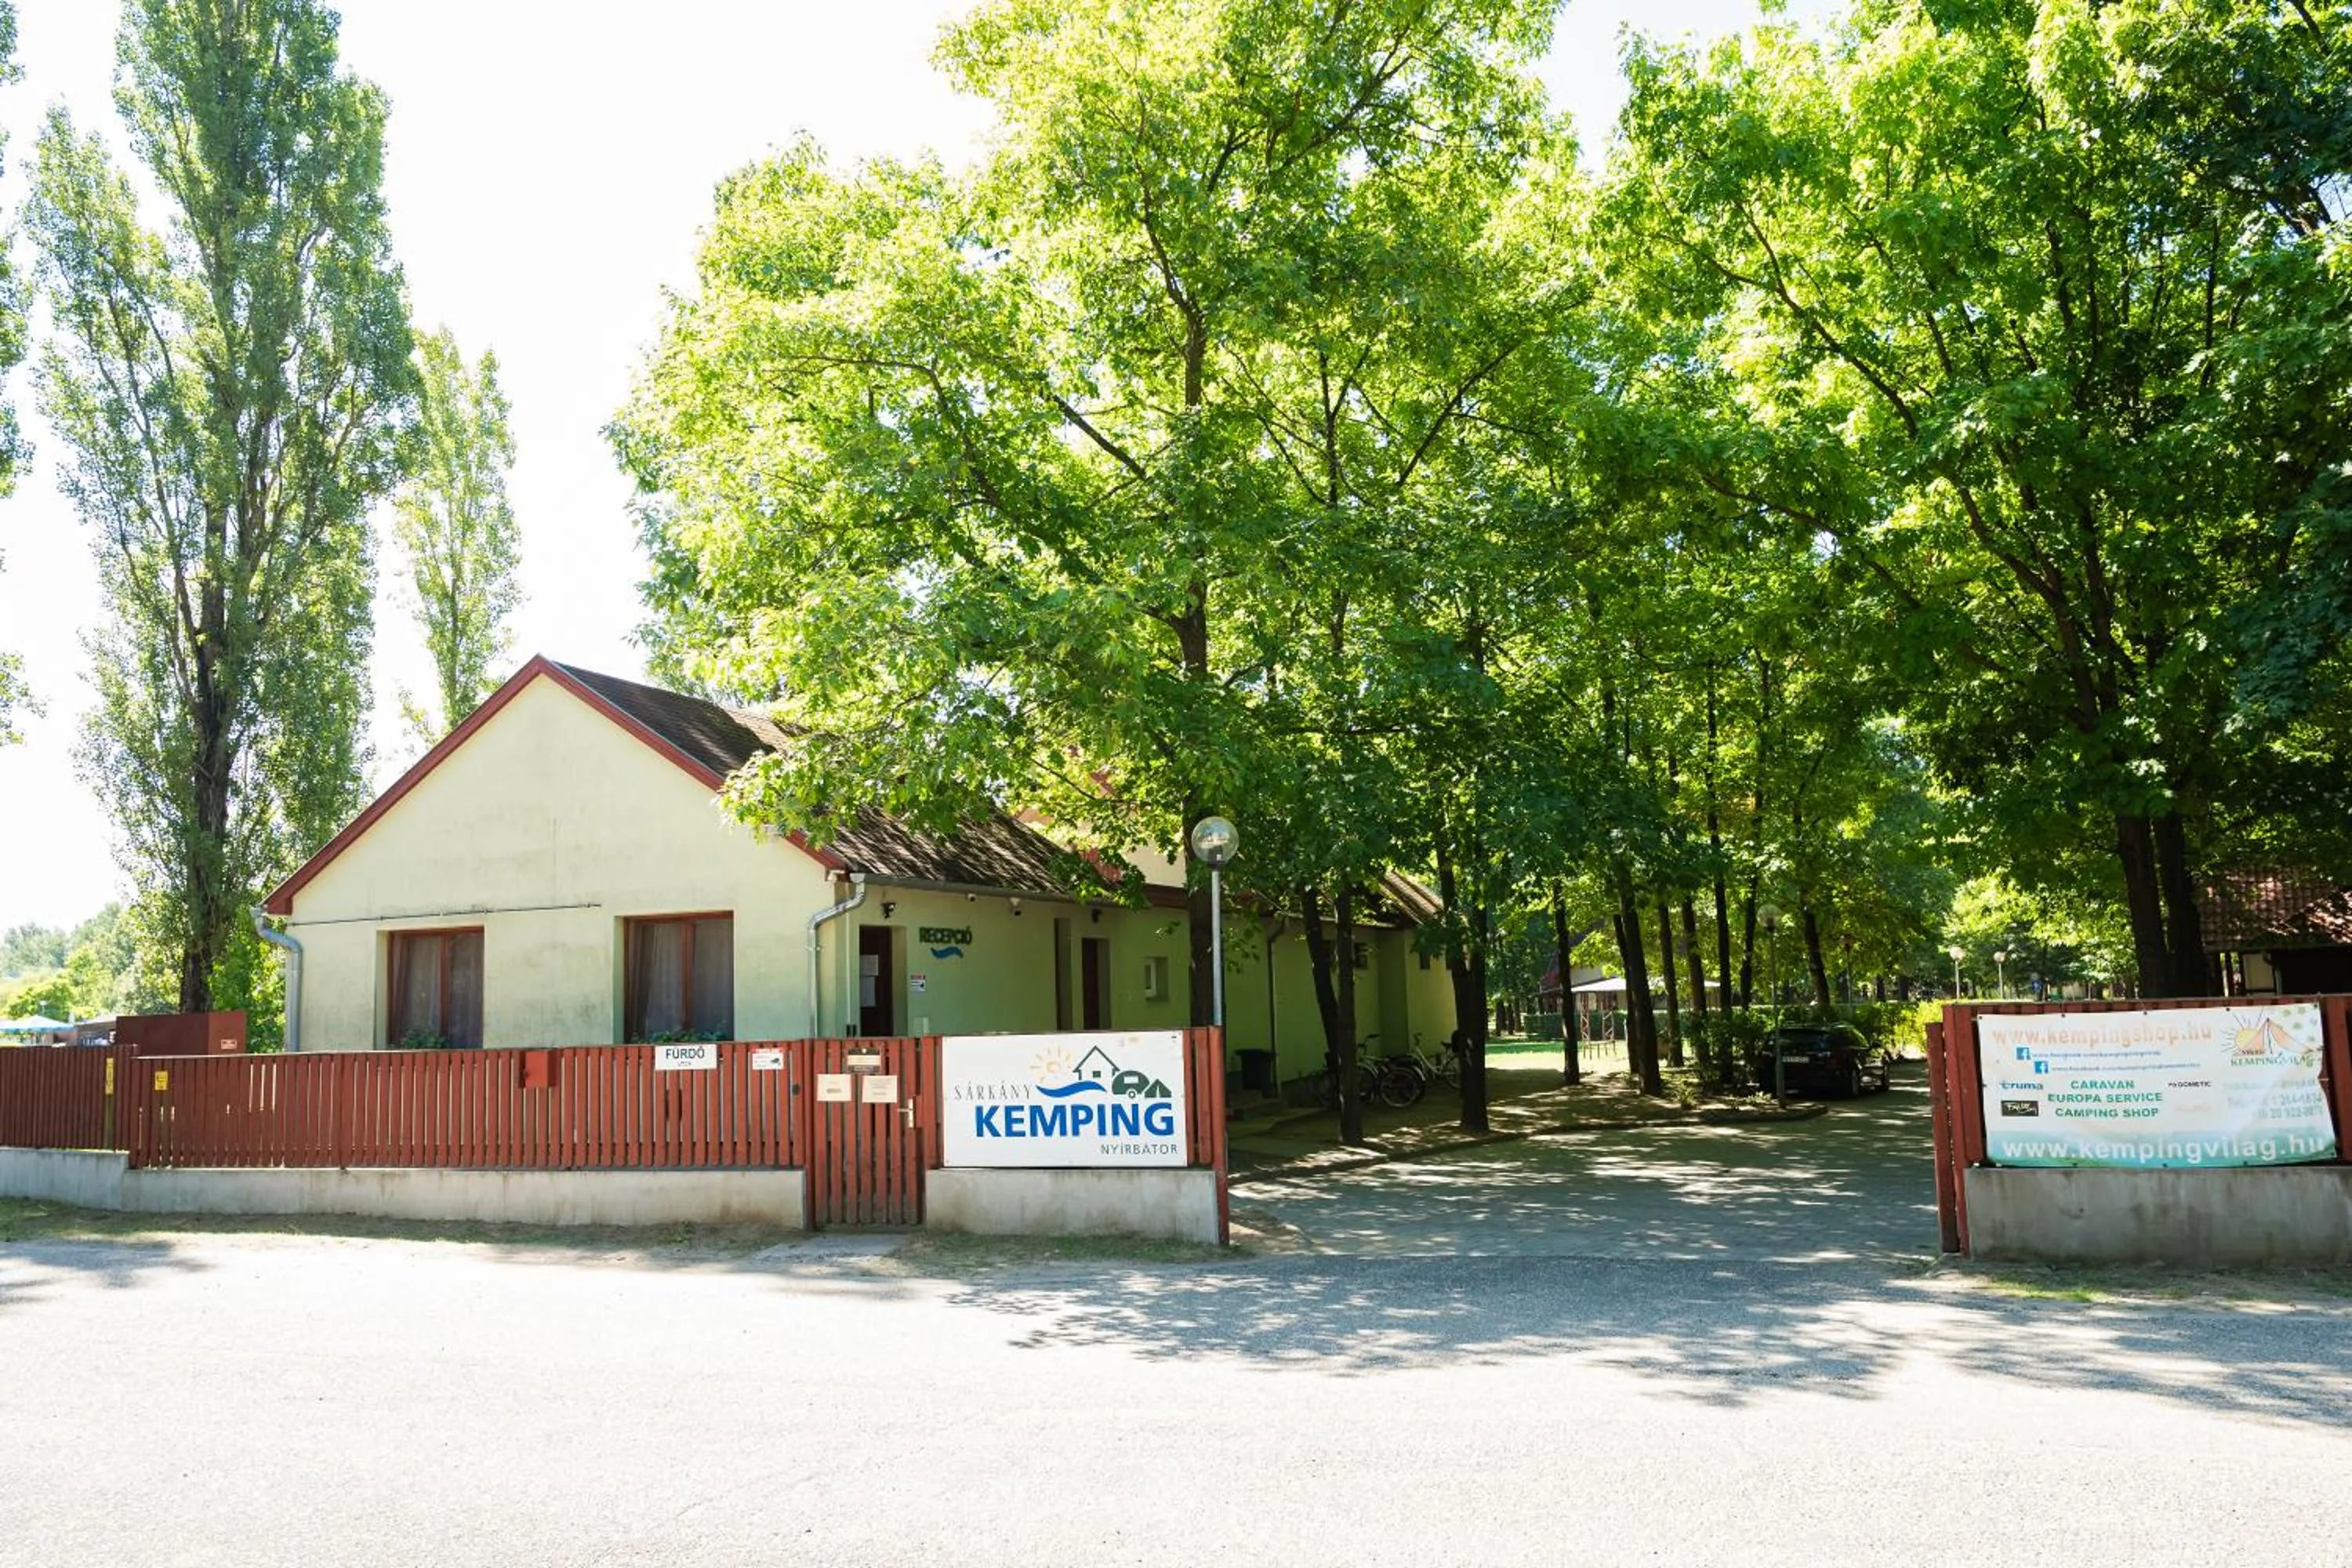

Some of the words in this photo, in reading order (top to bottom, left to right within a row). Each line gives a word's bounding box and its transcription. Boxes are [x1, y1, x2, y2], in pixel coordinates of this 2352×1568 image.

[919, 926, 973, 946] RECEPCIÓ
[1992, 1022, 2212, 1047] www.kempingshop.hu
[953, 1080, 1031, 1100] SÁRKÁNY
[2071, 1080, 2134, 1089] CARAVAN
[2048, 1094, 2101, 1103] EUROPA
[2107, 1092, 2163, 1102] SERVICE
[975, 1102, 1174, 1138] KEMPING
[2055, 1108, 2118, 1118] CAMPING
[2122, 1108, 2158, 1117] SHOP
[2002, 1134, 2325, 1162] www.kempingvilag.hu
